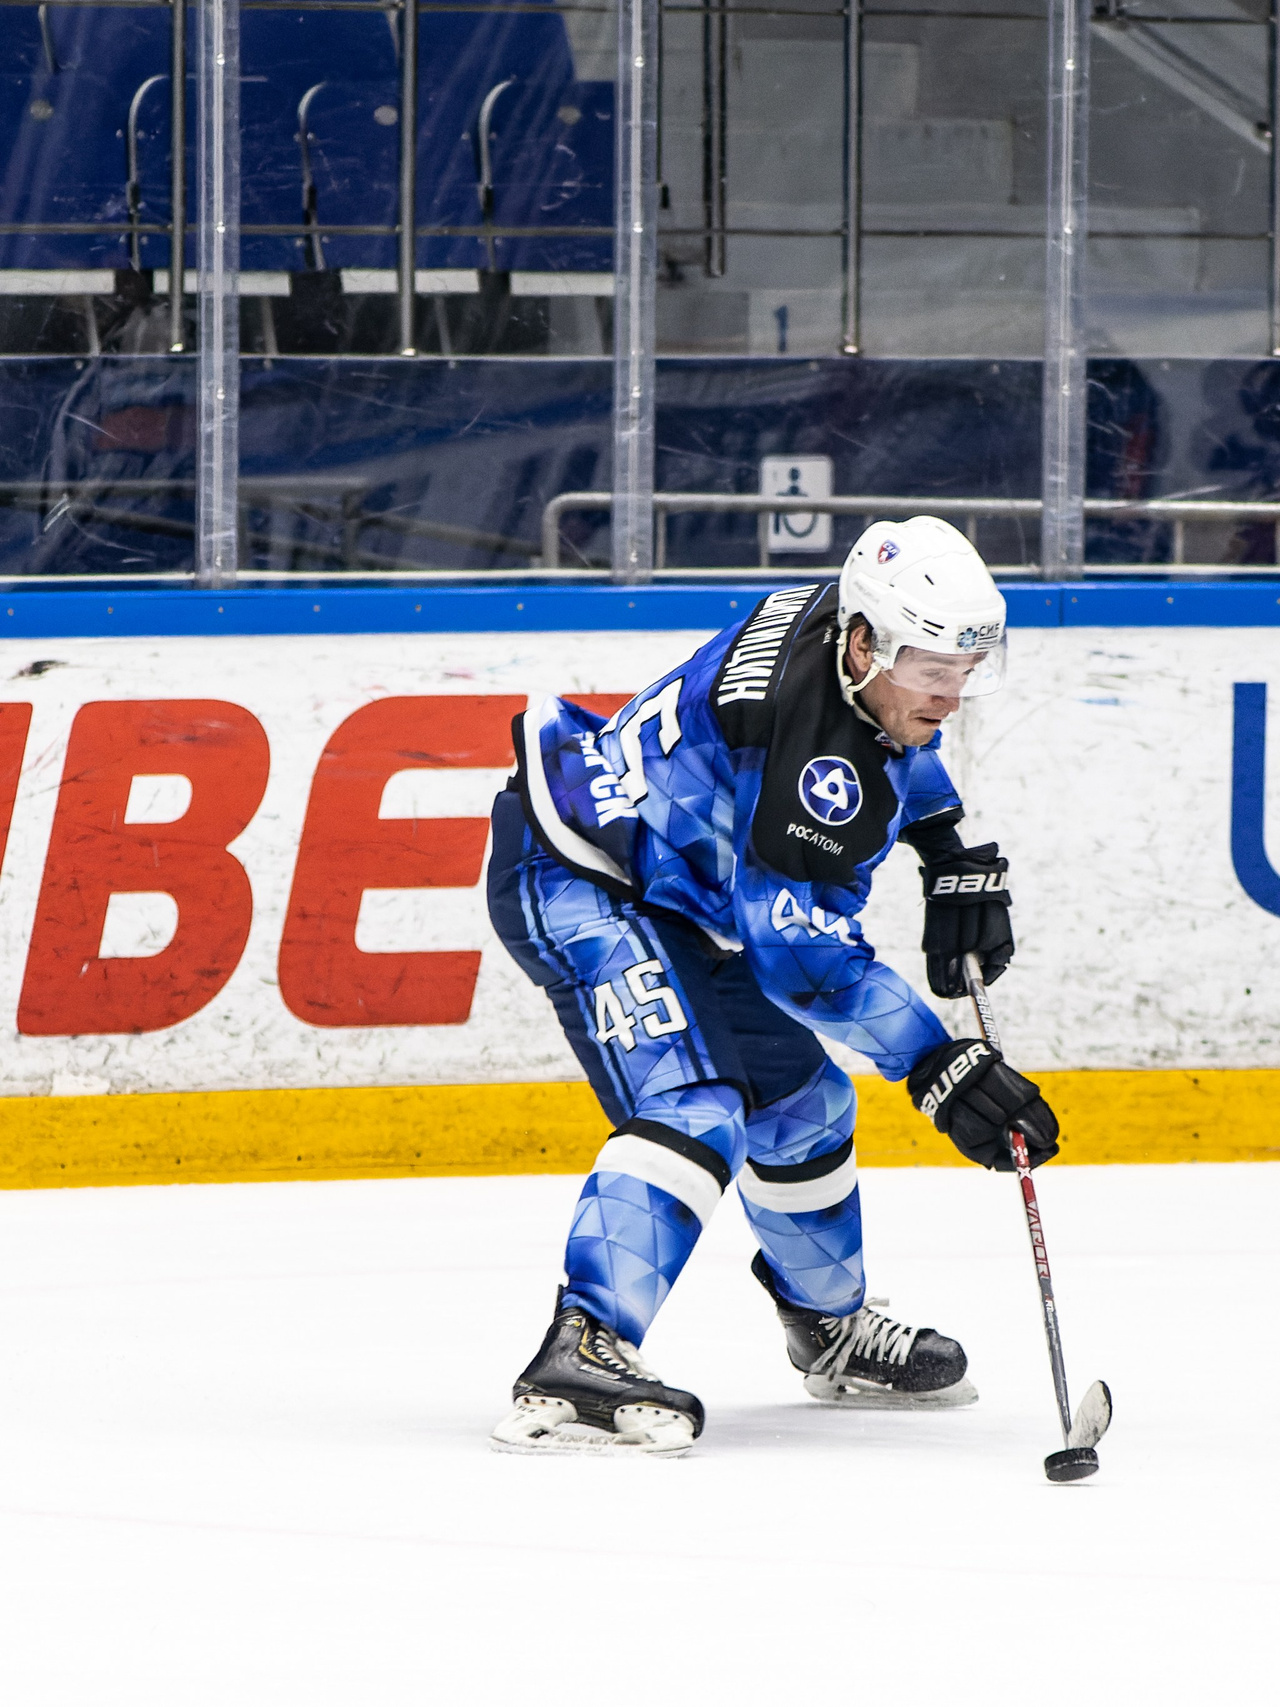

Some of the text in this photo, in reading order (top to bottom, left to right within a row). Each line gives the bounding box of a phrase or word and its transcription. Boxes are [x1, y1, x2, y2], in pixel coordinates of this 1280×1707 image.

[786, 823, 844, 856] РОСАТОМ
[931, 871, 1009, 896] BAU
[594, 958, 688, 1052] 45
[920, 1041, 992, 1124] AUER
